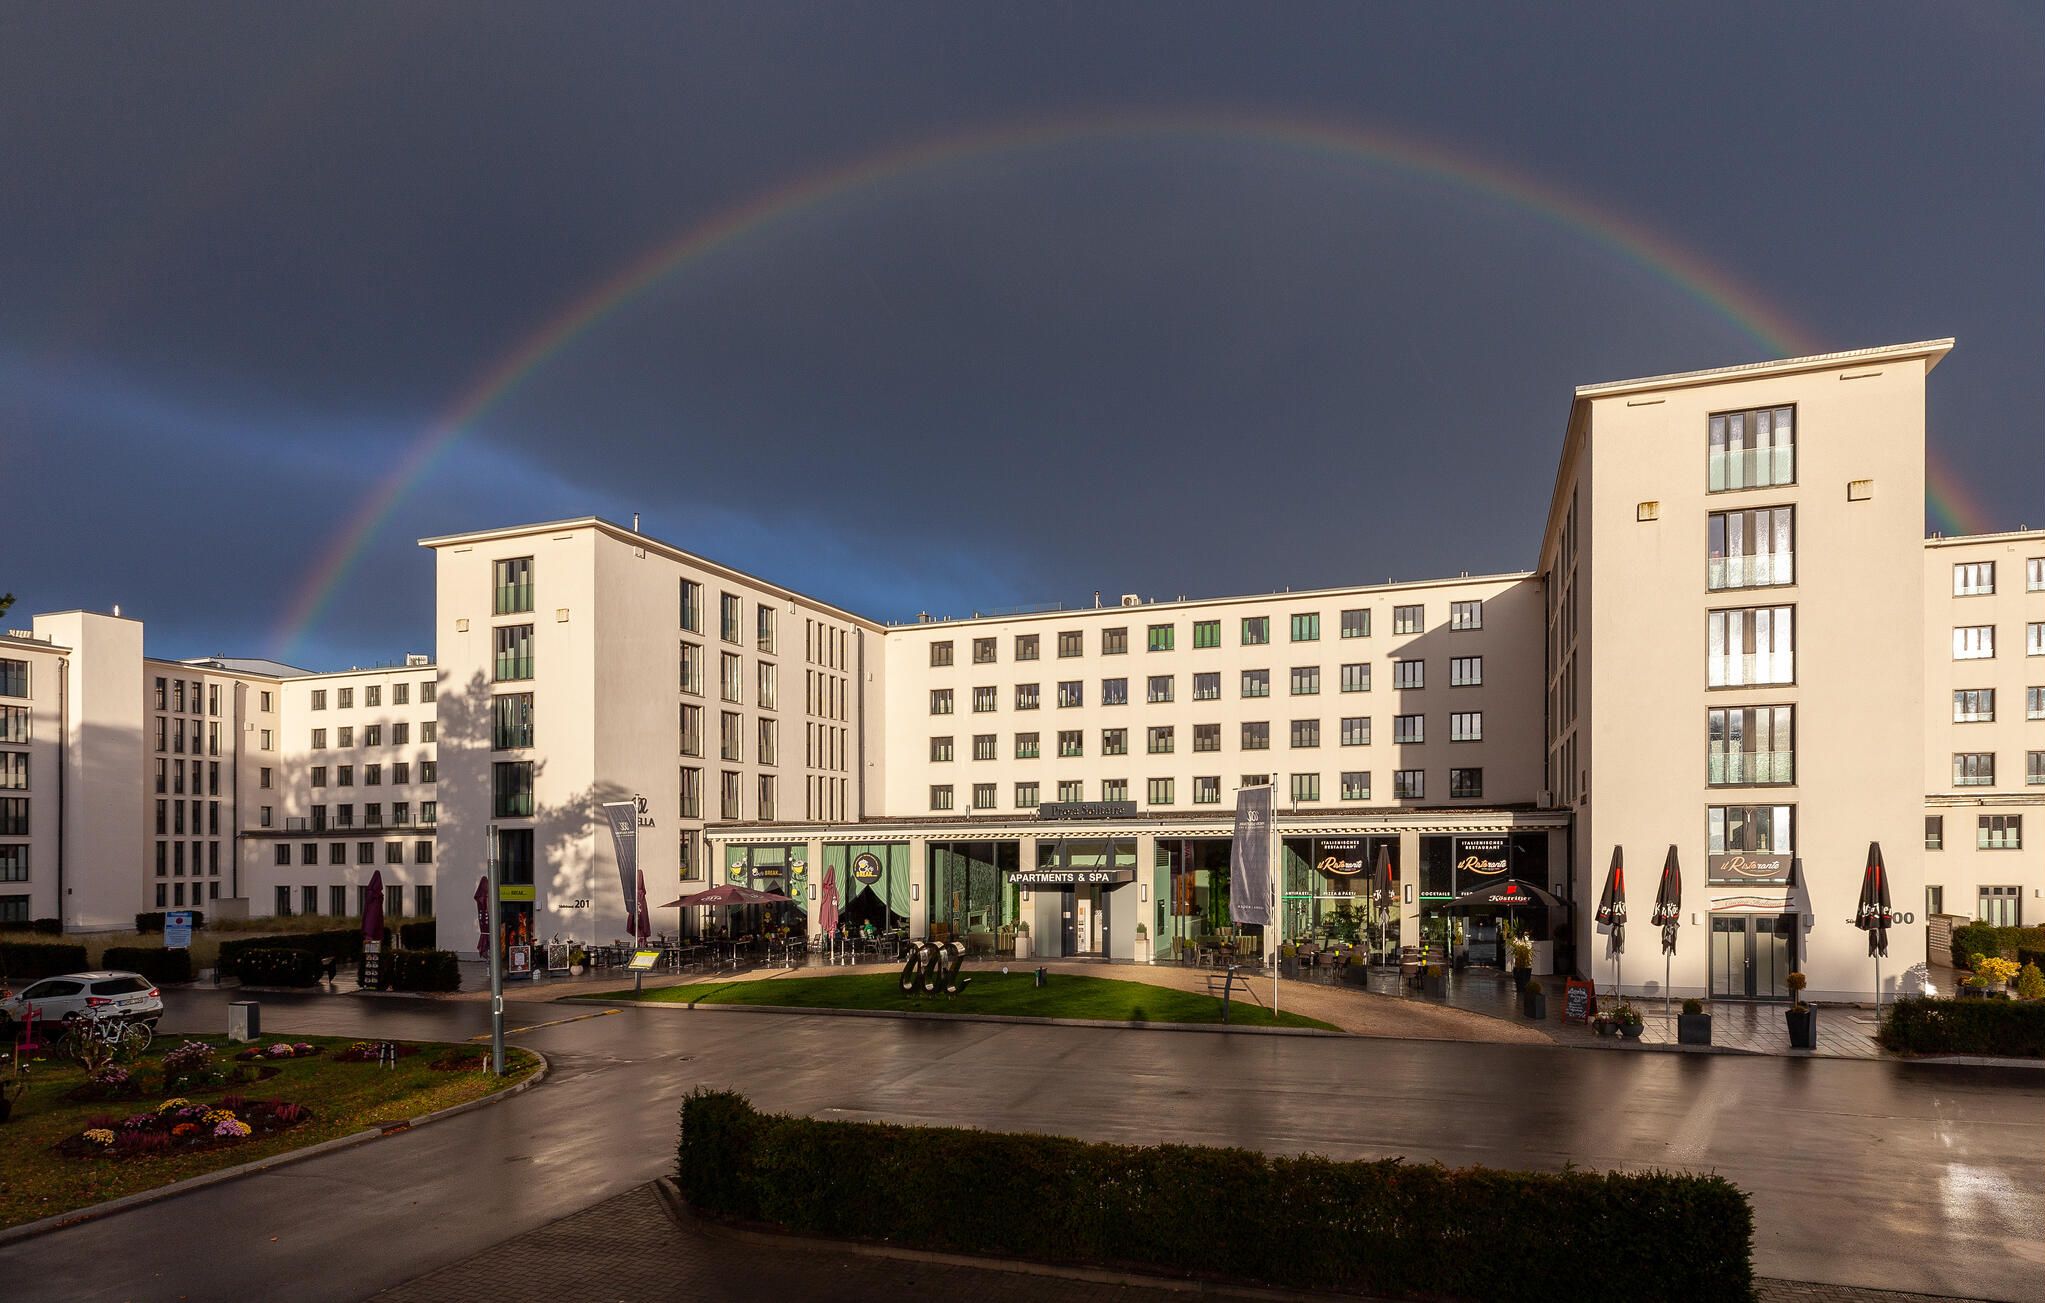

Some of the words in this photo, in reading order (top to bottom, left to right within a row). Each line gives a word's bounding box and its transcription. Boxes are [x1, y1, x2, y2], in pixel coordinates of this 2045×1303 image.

[1051, 806, 1080, 816] Prora
[1082, 804, 1125, 815] Solitaire
[1009, 873, 1074, 883] APARTMENTS
[1078, 873, 1085, 882] &
[1089, 873, 1110, 882] SPA
[1488, 894, 1532, 902] Köstritzer
[574, 899, 590, 908] 201
[1892, 912, 1915, 925] 00
